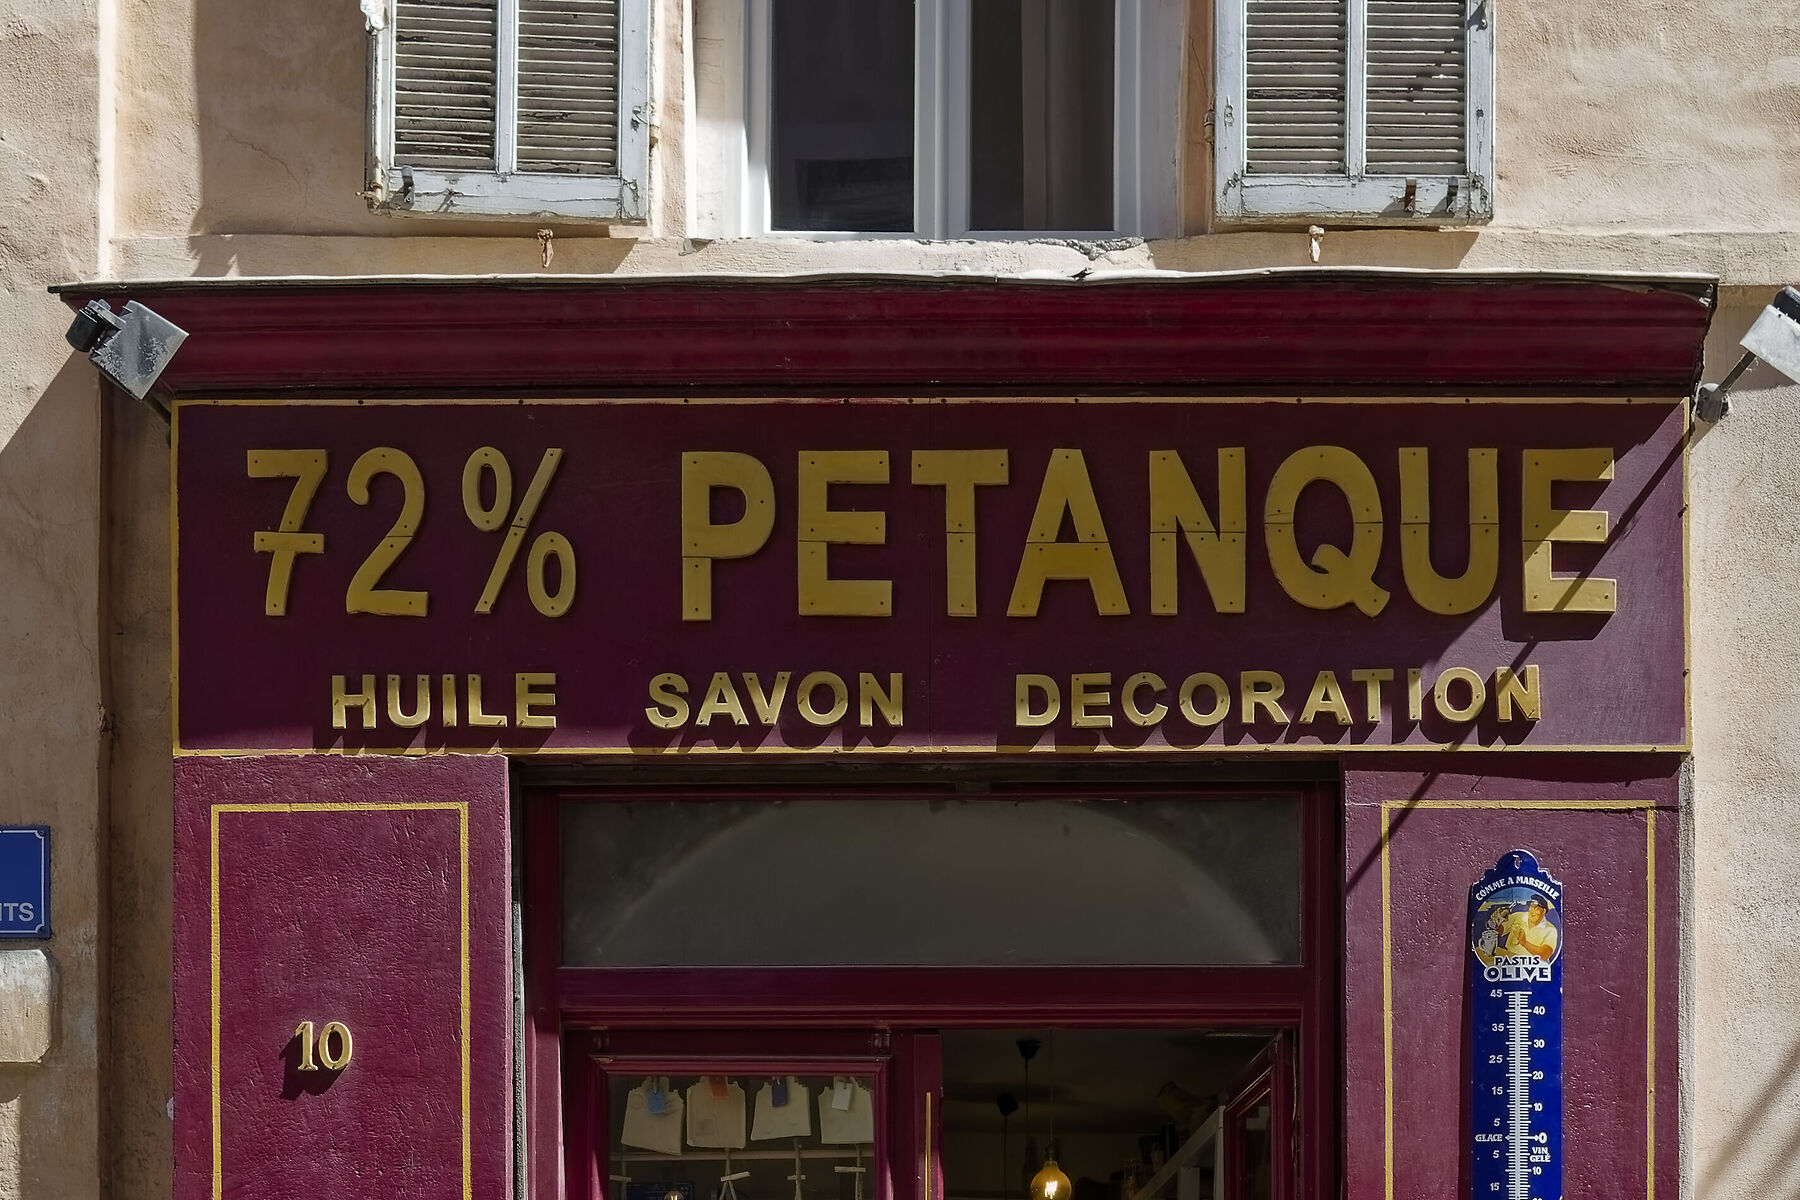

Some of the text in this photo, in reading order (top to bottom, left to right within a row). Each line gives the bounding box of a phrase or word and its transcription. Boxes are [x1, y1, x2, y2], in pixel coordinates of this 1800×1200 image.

[681, 445, 1617, 621] PETANQUE
[331, 664, 1542, 730] HUILE SAVON DECORATION
[1475, 875, 1560, 901] COMME A MARSEILLE
[1494, 956, 1541, 966] PASTIS
[1485, 966, 1550, 981] OLIVE
[1490, 989, 1503, 998] 45
[1533, 1006, 1545, 1015] 40
[1491, 1023, 1505, 1032] 35
[294, 1020, 353, 1072] 10
[1533, 1039, 1545, 1048] 30
[1489, 1055, 1503, 1064] 25
[1532, 1071, 1544, 1080] 20
[1491, 1087, 1503, 1095] 15
[1533, 1103, 1543, 1112] 10
[1493, 1118, 1501, 1127] 5
[1475, 1133, 1503, 1142] GLACE
[1538, 1132, 1548, 1144] 0
[1493, 1150, 1500, 1158] 5
[1531, 1146, 1549, 1155] VIN
[1532, 1167, 1542, 1175] 10
[1490, 1183, 1500, 1191] 15
